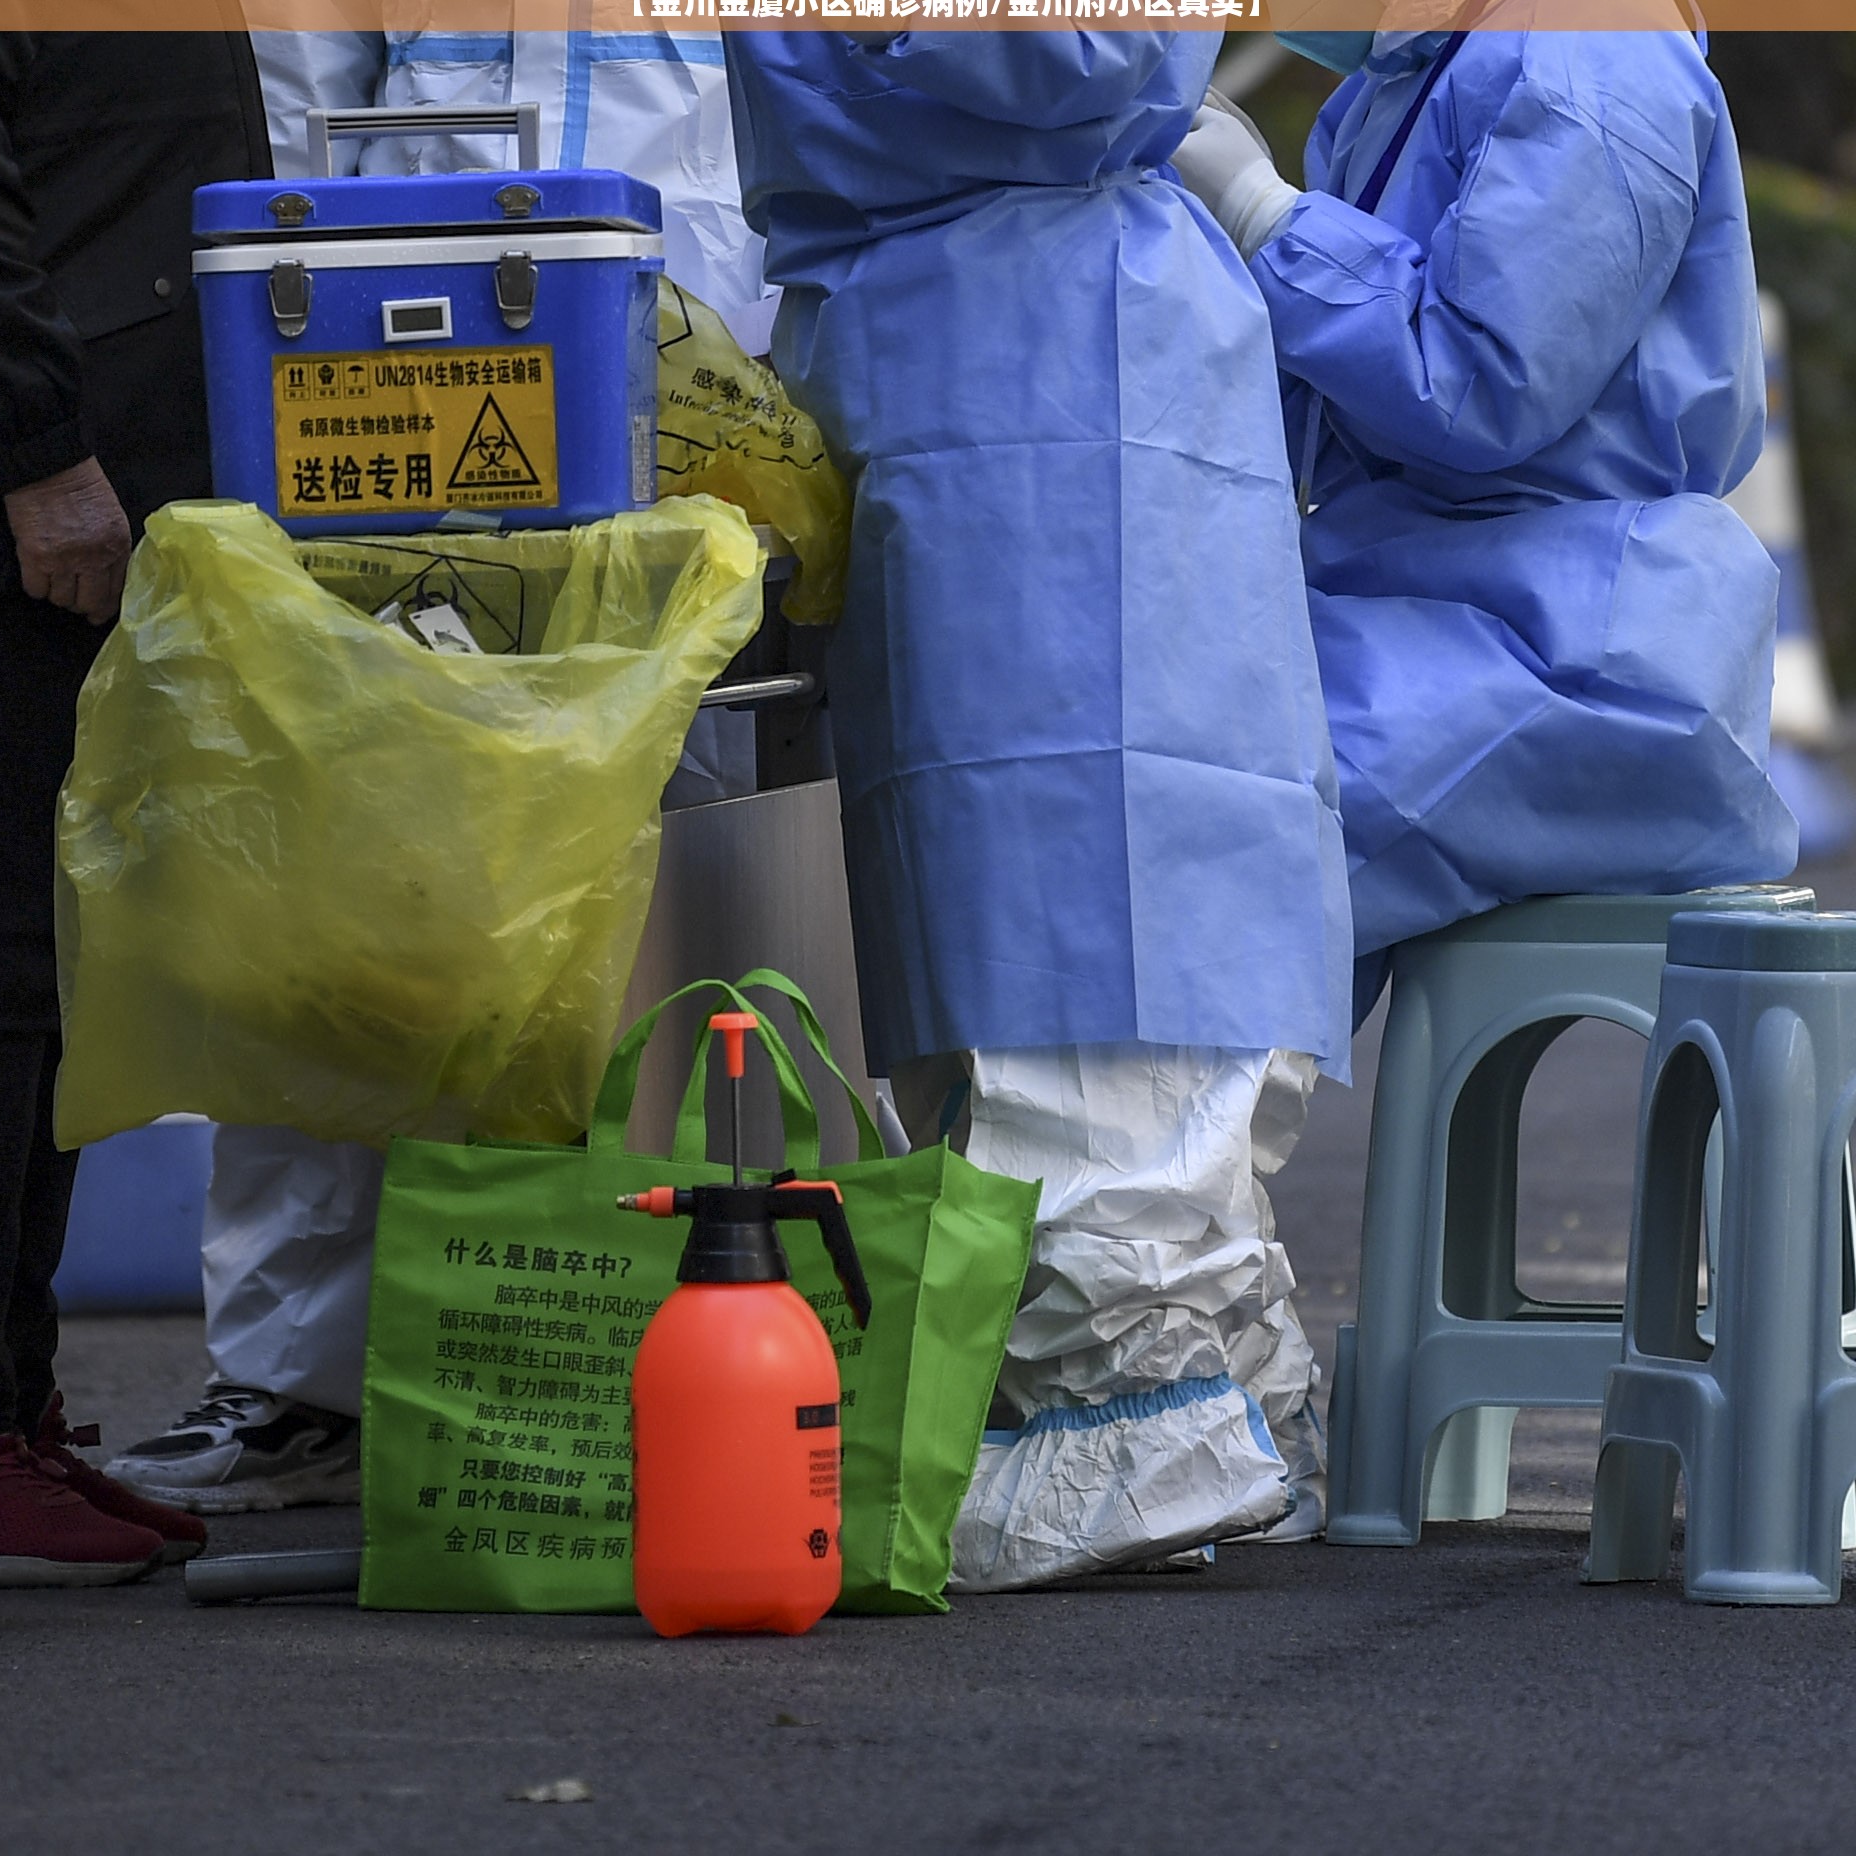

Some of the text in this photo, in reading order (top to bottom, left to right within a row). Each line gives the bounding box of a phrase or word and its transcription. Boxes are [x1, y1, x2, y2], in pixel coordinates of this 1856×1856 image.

[374, 357, 542, 388] UN2814生物安全运输箱
[299, 413, 436, 438] 病原微生物检验样本
[292, 452, 433, 504] 送检专用
[444, 1525, 633, 1561] 金凤区疾病预
